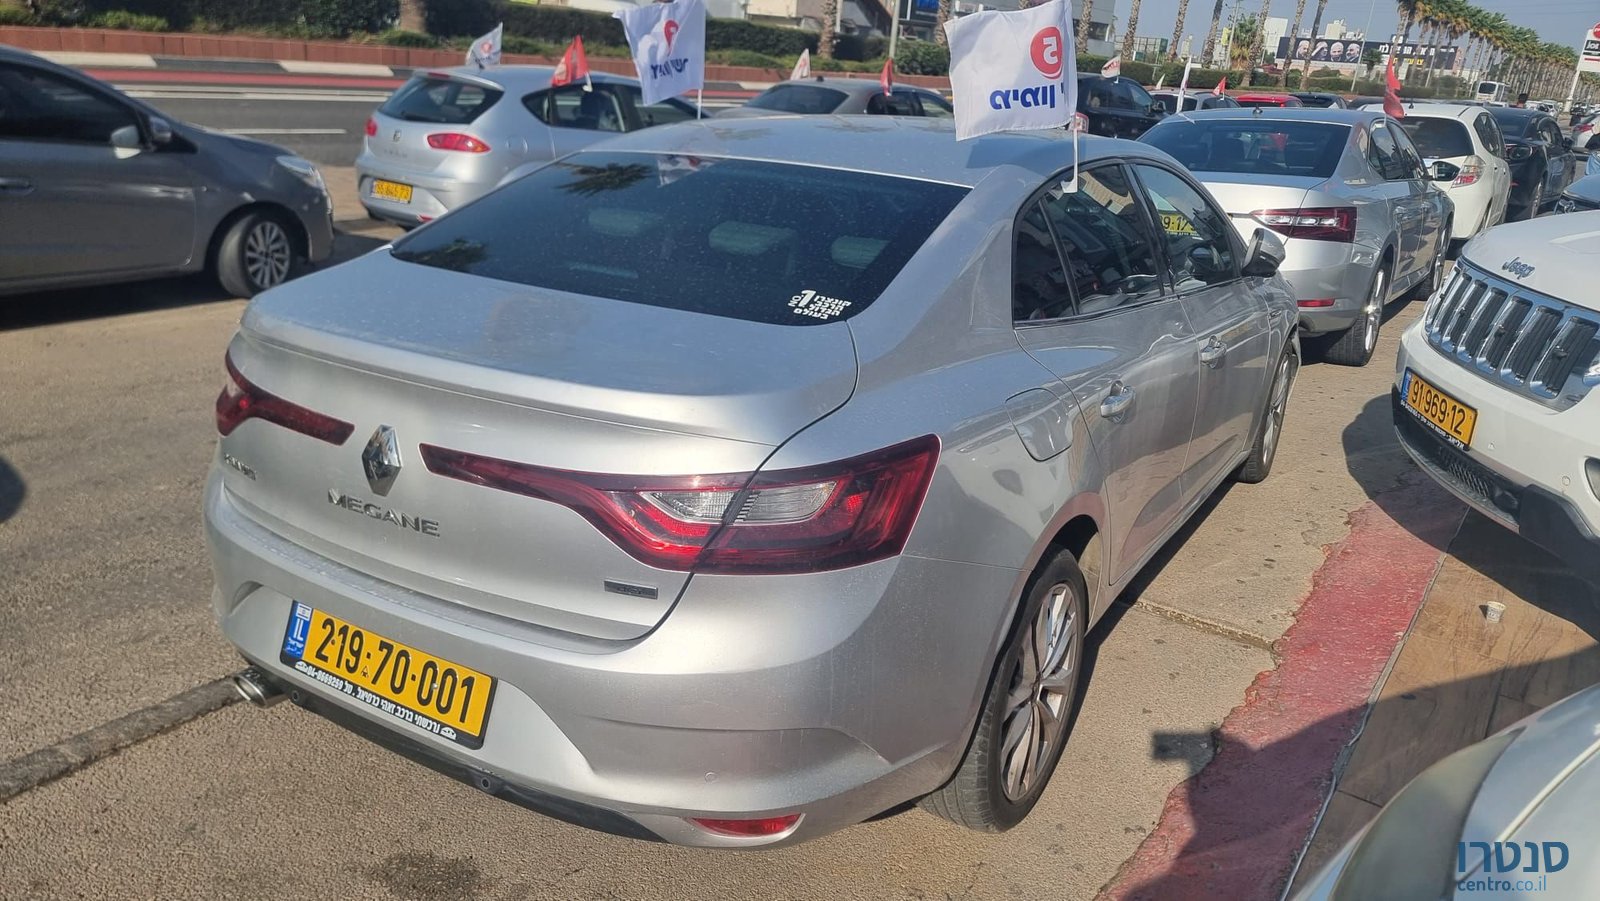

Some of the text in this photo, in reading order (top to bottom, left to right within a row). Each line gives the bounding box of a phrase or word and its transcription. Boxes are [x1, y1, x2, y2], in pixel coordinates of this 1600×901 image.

[1502, 256, 1535, 280] Jeep
[328, 488, 440, 537] MEGANE
[293, 618, 304, 641] IL
